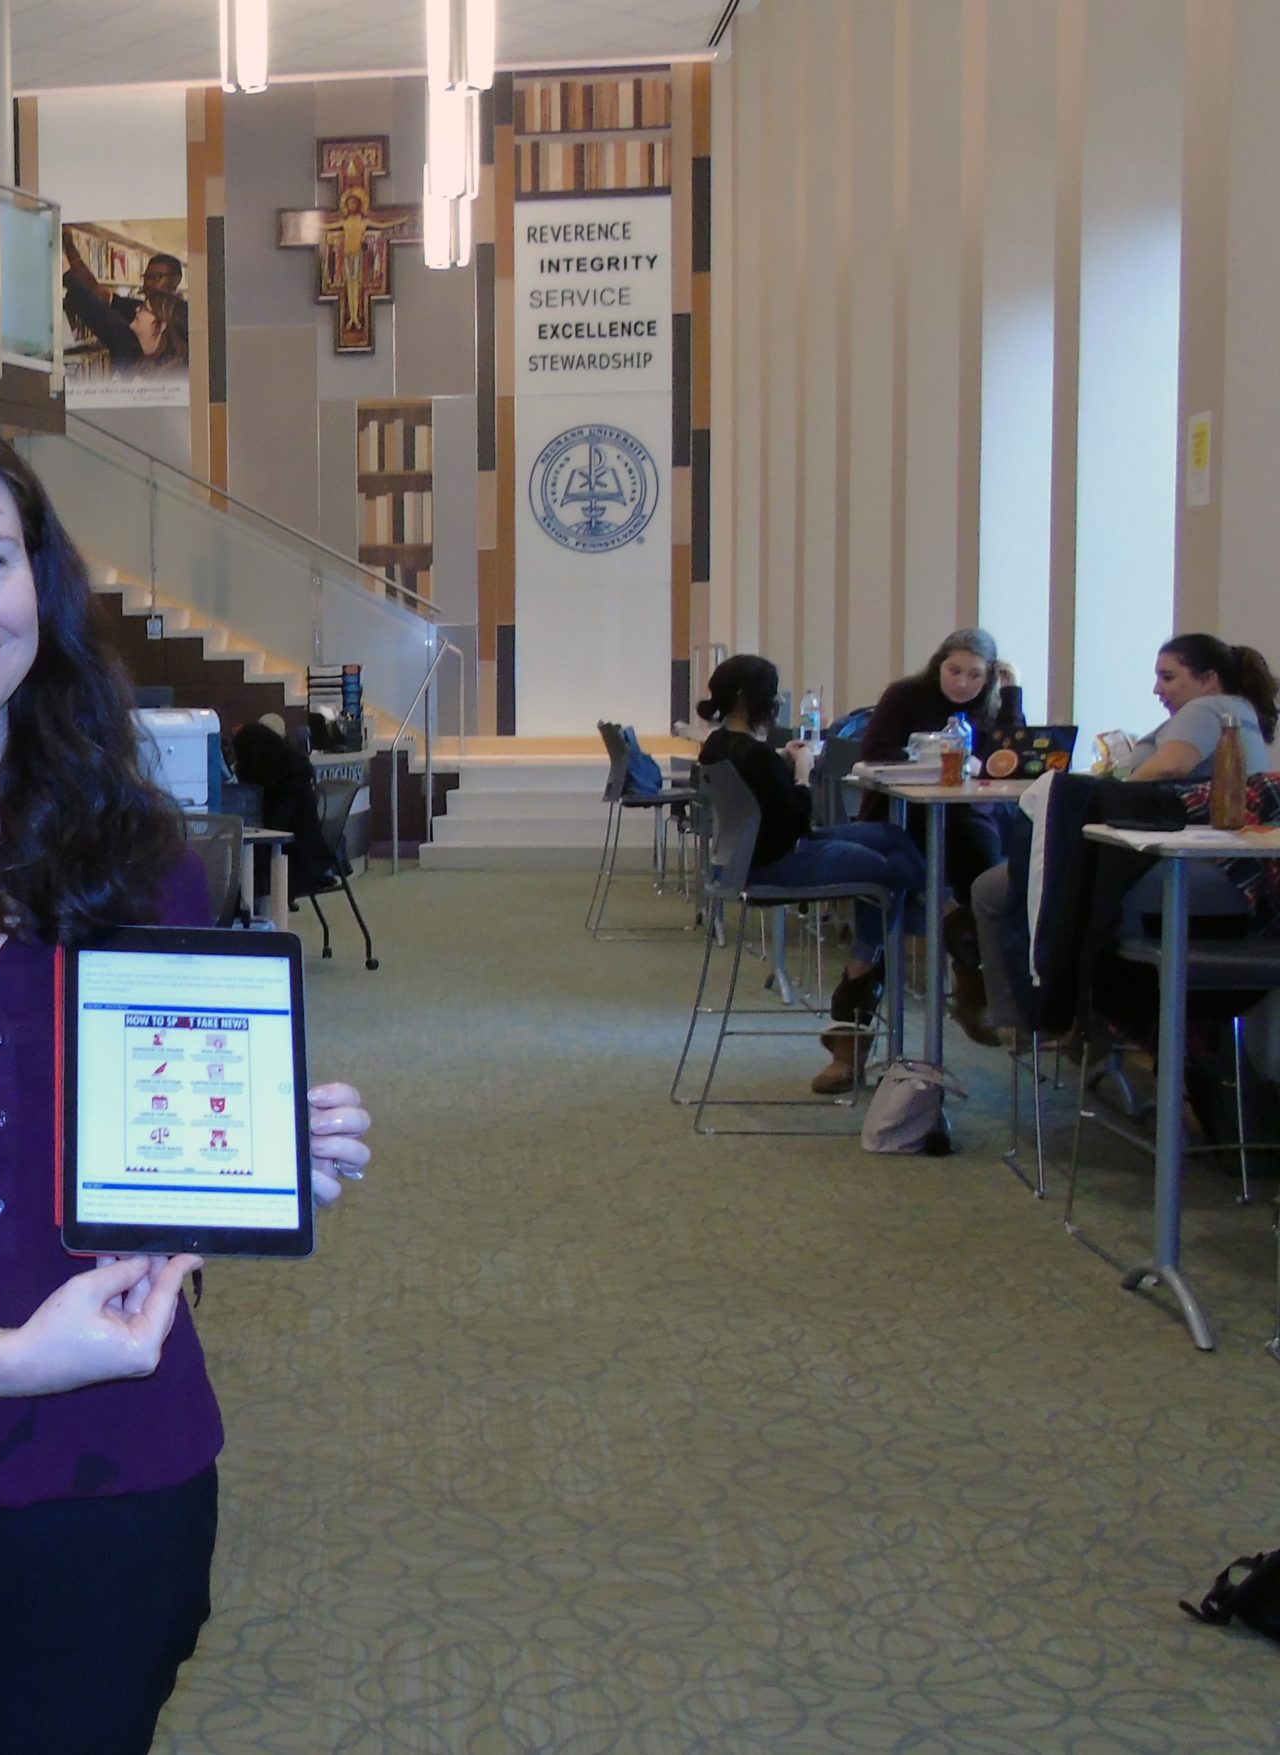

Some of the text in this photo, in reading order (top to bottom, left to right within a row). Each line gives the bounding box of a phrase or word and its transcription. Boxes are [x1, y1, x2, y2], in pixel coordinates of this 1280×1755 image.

[527, 222, 632, 244] REVERENCE
[540, 254, 658, 273] INTEGRITY
[529, 287, 632, 309] SERVICE
[538, 320, 657, 340] EXCELLENCE
[528, 352, 653, 372] STEWARDSHIP
[126, 1014, 150, 1027] HOW
[152, 1015, 164, 1027] TO
[197, 1017, 219, 1029] FAKE
[221, 1018, 248, 1030] NEWS
